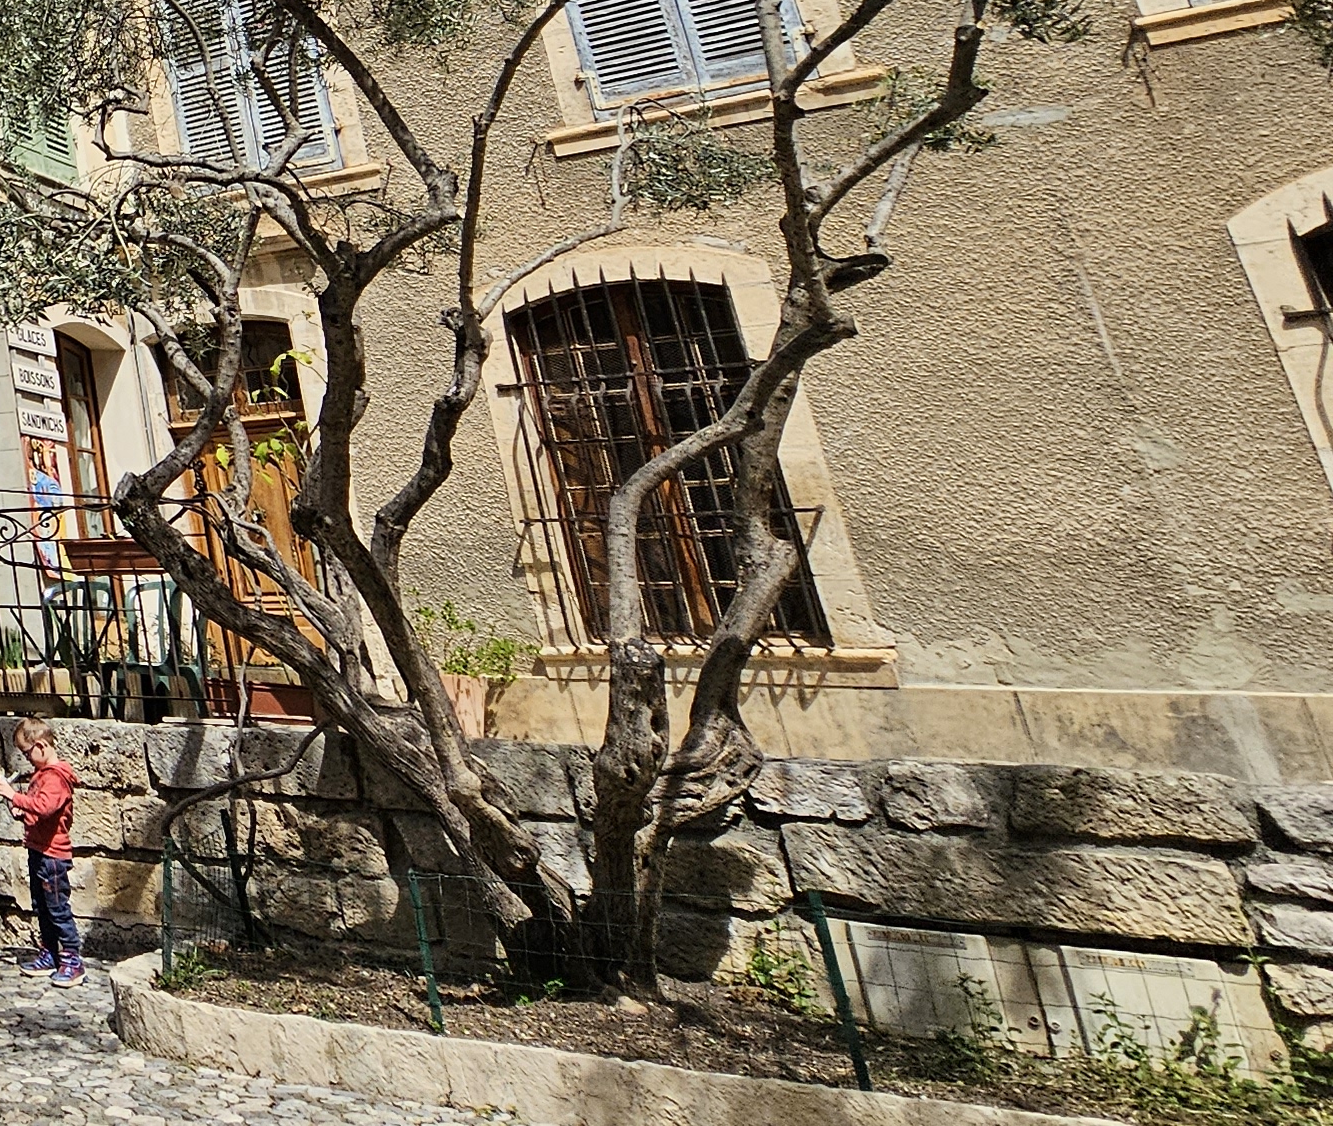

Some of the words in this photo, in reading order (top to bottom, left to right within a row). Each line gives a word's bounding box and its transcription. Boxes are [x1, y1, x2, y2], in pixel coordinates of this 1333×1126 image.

[16, 328, 47, 347] GLACES
[18, 367, 55, 390] BOISSONS
[21, 411, 65, 434] SANDWICHS
